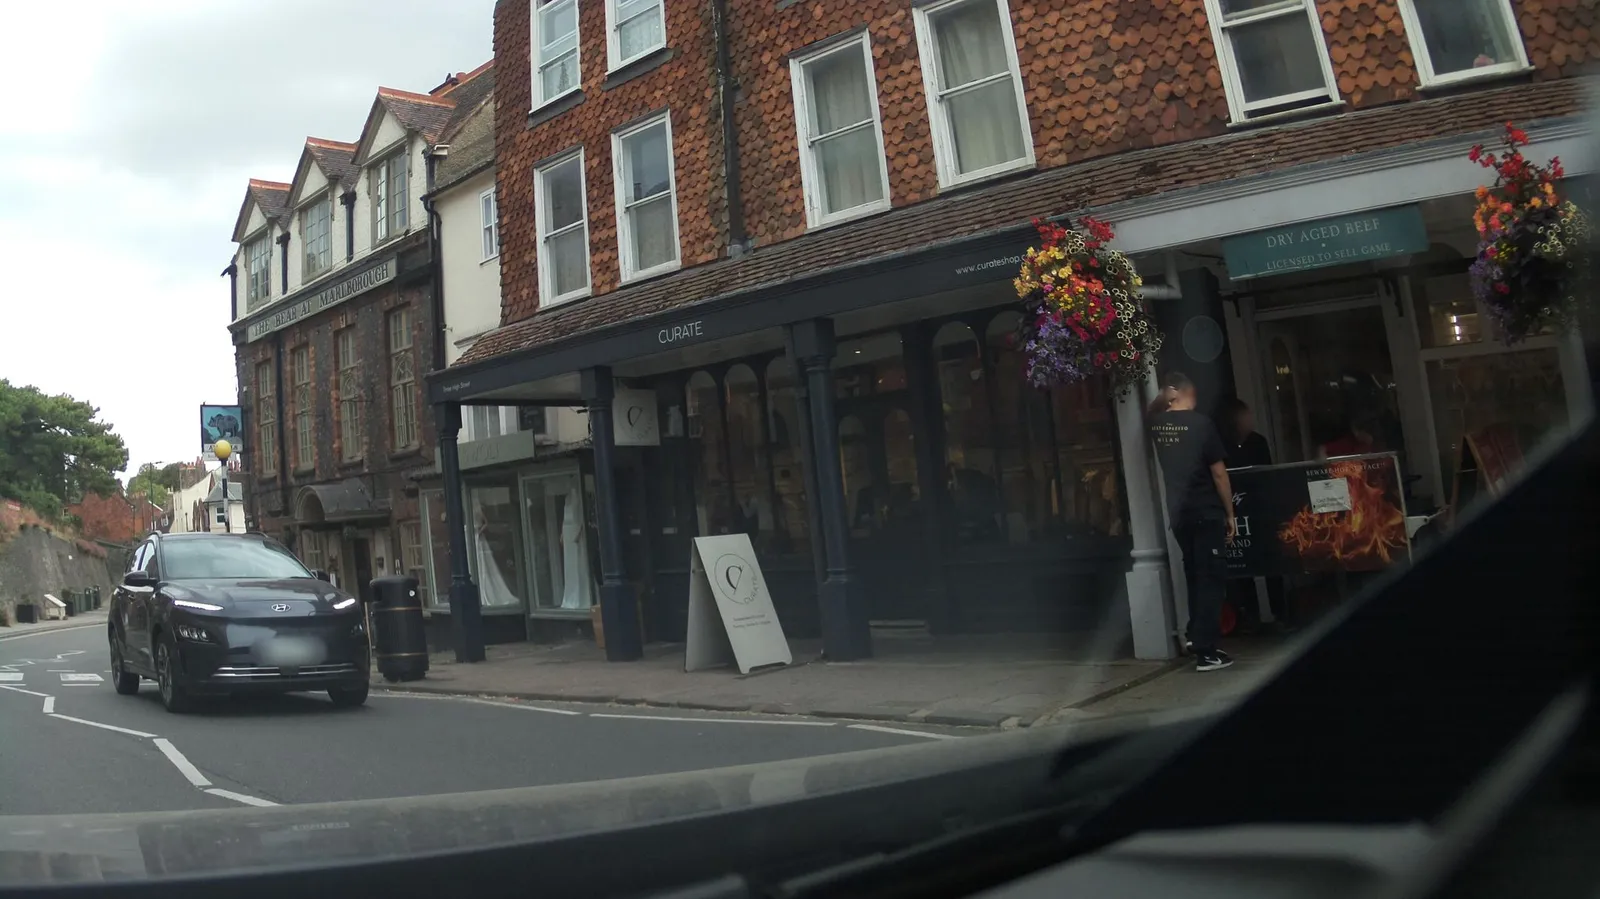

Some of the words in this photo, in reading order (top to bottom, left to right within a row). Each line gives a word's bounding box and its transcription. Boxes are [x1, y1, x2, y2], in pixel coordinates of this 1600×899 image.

[1266, 232, 1295, 248] DRY
[1300, 224, 1340, 243] AGED
[1345, 218, 1380, 235] BEEF
[1266, 255, 1315, 270] LICENSED
[1317, 252, 1332, 262] TO
[1334, 248, 1359, 259] SELL
[1361, 242, 1392, 256] GAME
[253, 319, 270, 337] THE
[274, 307, 297, 328] BEAR
[300, 301, 312, 316] AT
[319, 263, 389, 307] MARLBOROUGH
[658, 320, 703, 344] CURATE
